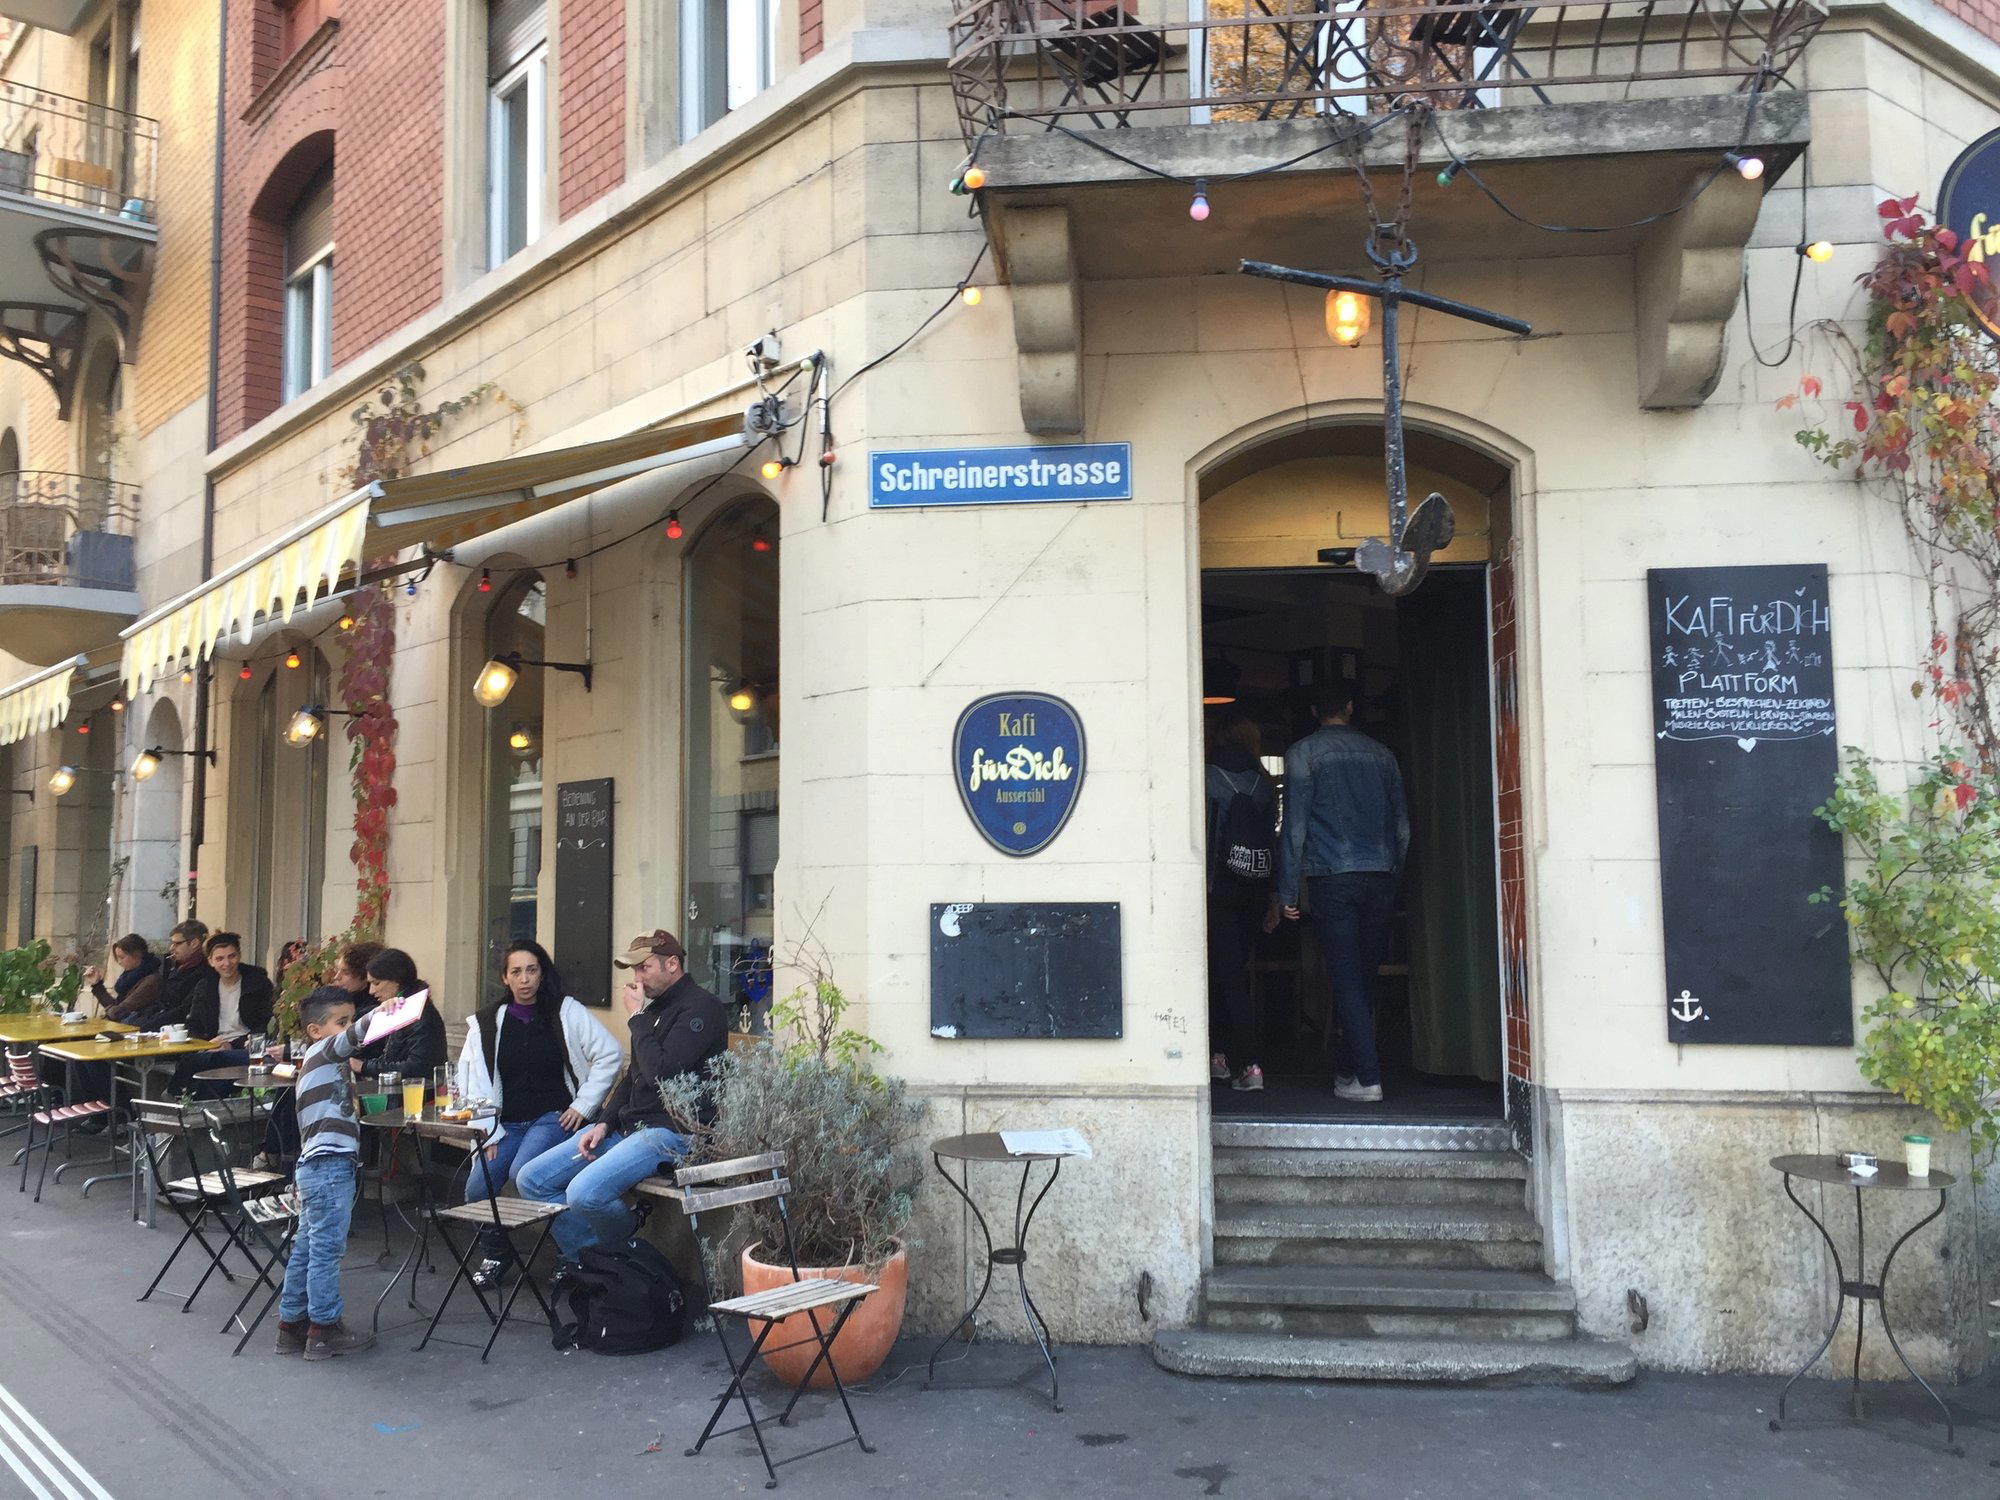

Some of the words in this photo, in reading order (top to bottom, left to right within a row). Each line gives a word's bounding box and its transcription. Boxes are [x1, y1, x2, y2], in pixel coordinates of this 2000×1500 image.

[879, 458, 1121, 492] Schreinerstrasse
[1679, 671, 1799, 694] PLATTFORM
[999, 713, 1035, 736] Kafi
[996, 787, 1045, 803] Aussersihl
